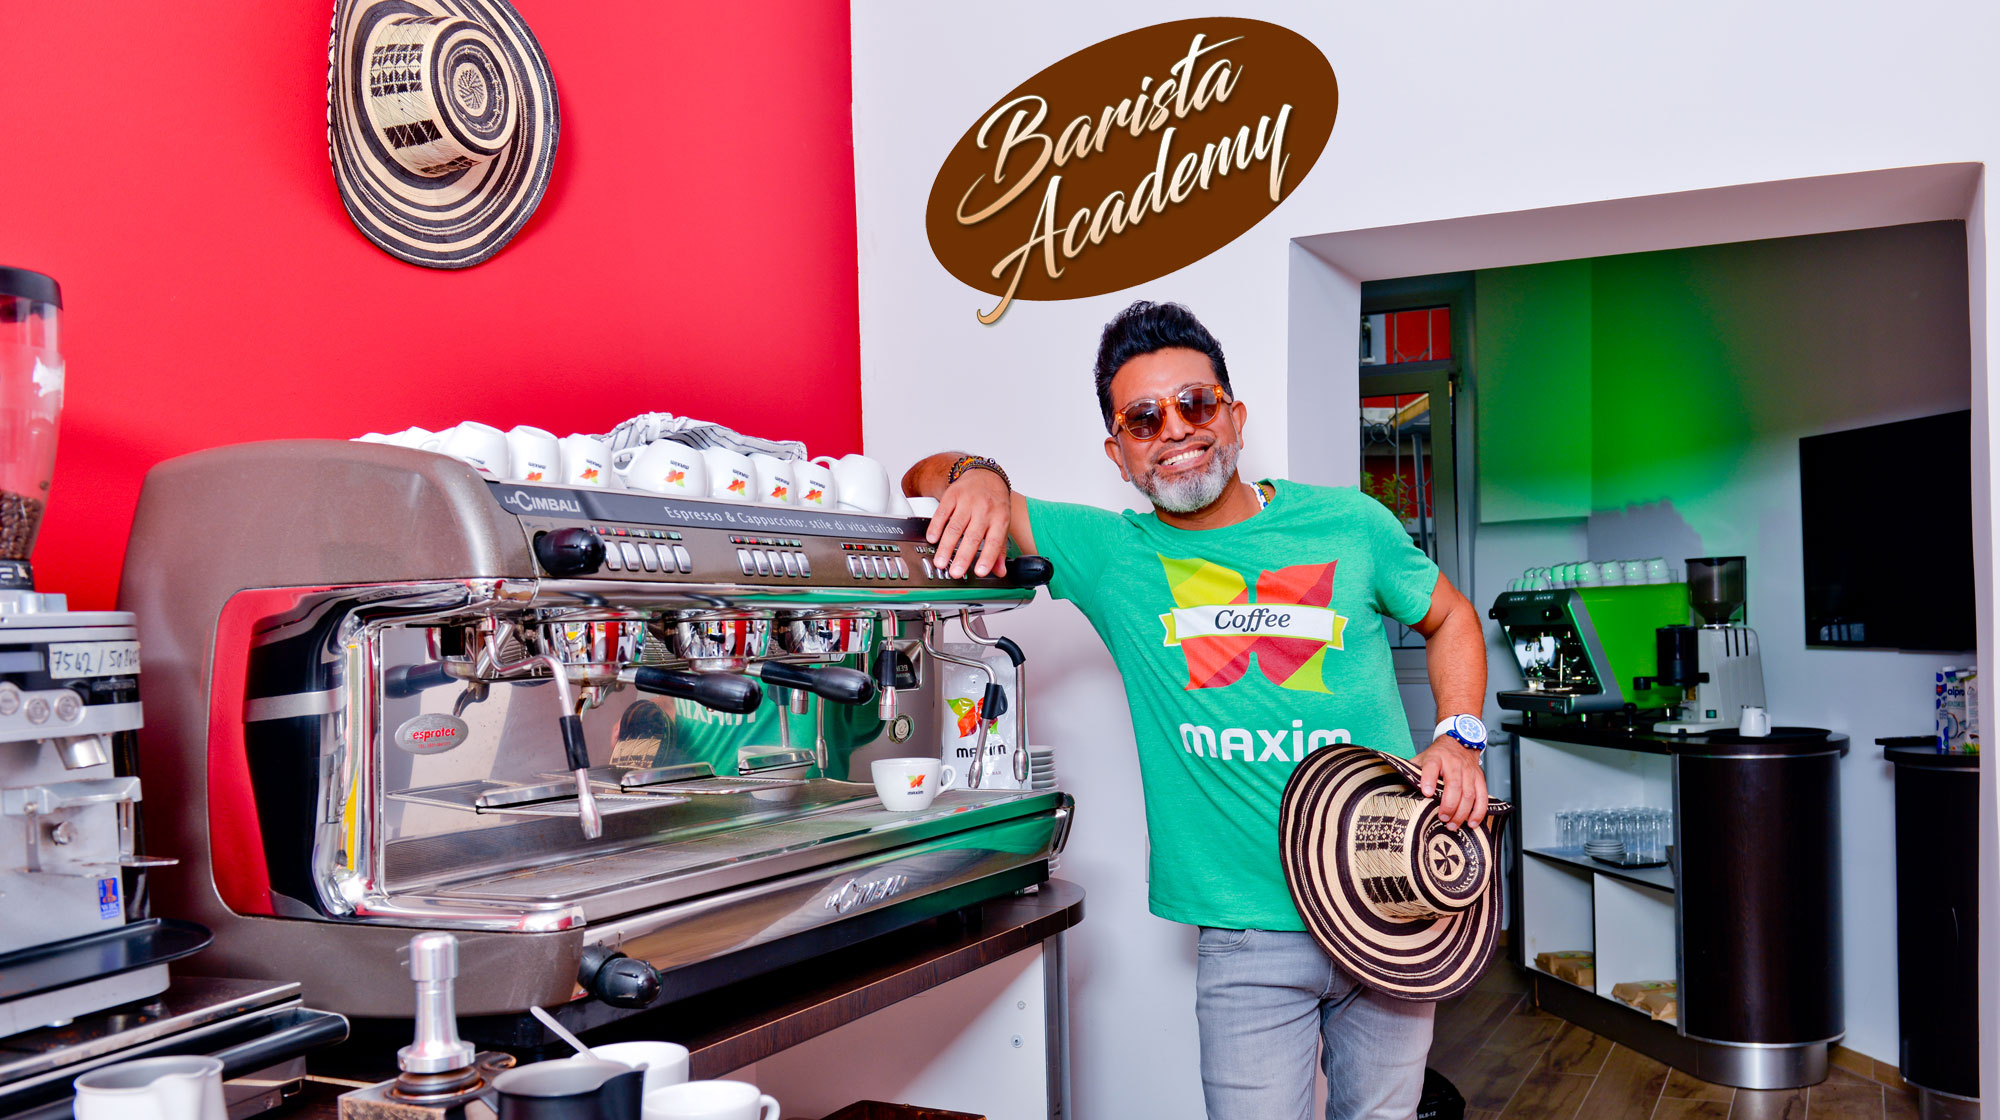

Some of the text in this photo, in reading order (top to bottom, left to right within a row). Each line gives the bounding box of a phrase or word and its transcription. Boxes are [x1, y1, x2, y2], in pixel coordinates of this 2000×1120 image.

[663, 506, 904, 535] Espresso & Cappuccino: stile di vita italiano
[1214, 607, 1291, 633] Coffee
[412, 727, 456, 742] esprotec
